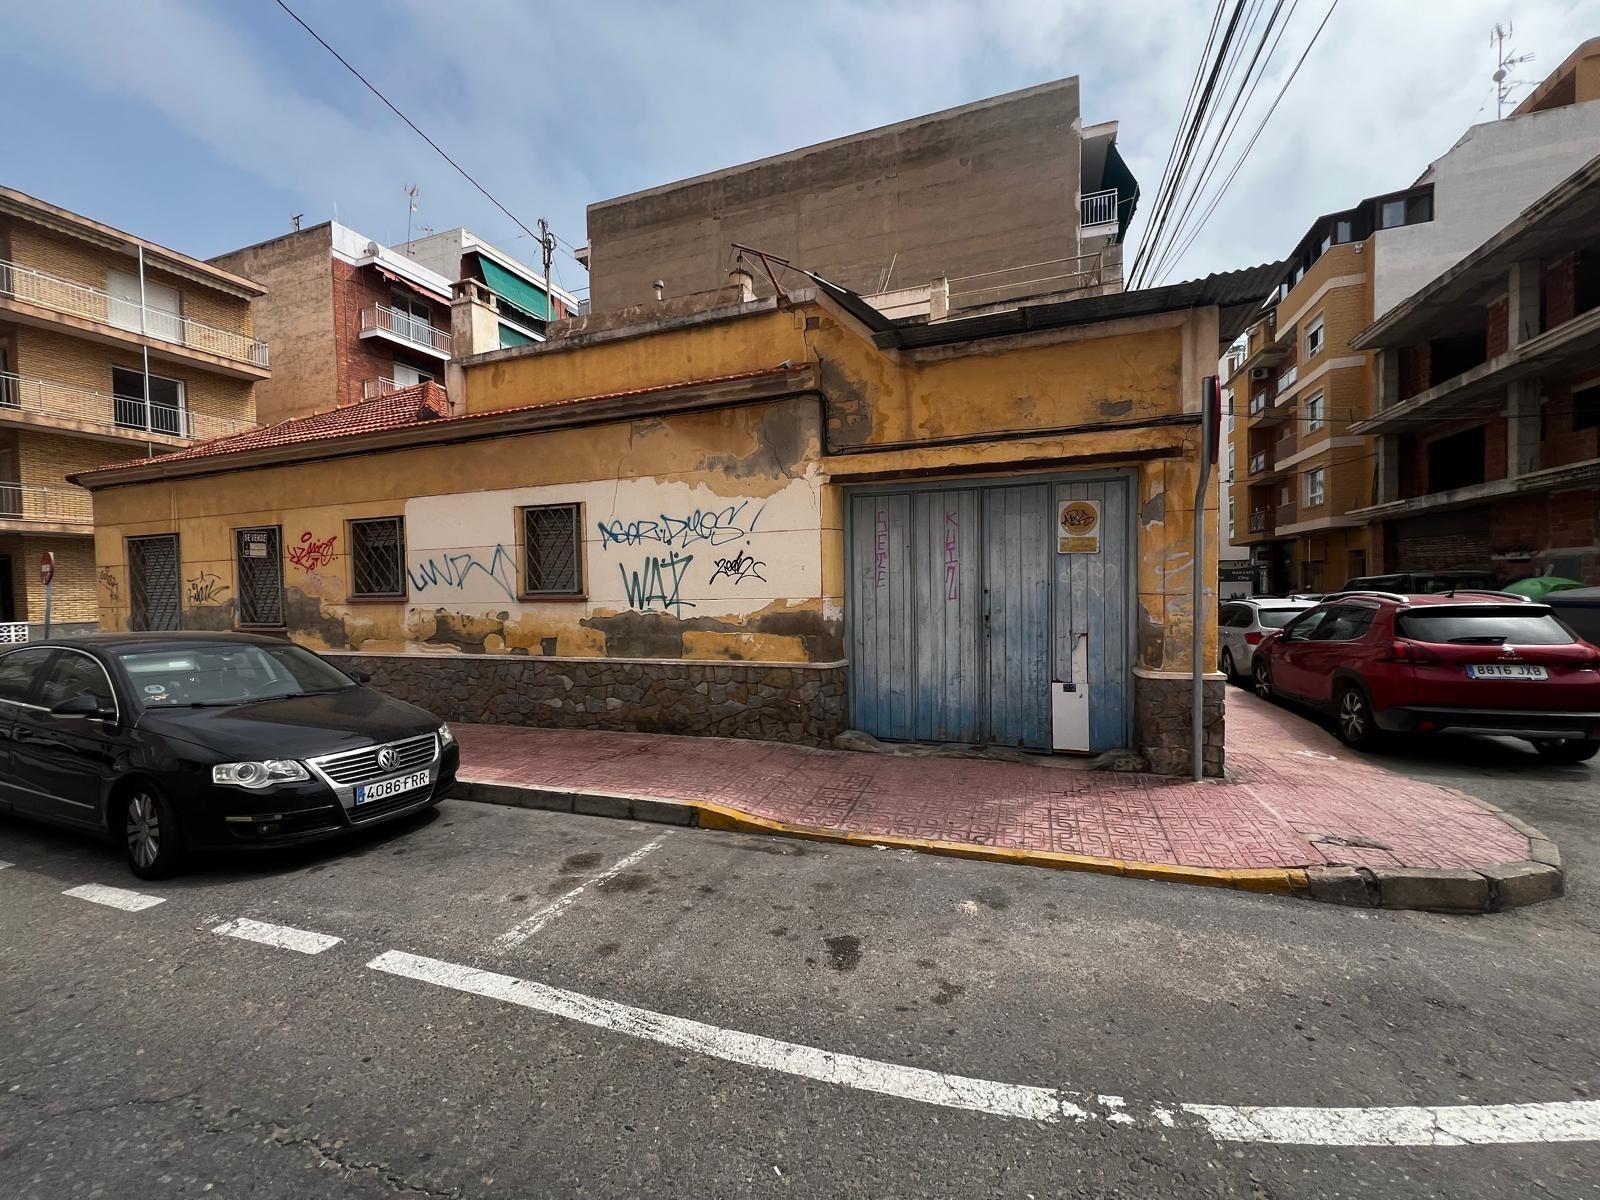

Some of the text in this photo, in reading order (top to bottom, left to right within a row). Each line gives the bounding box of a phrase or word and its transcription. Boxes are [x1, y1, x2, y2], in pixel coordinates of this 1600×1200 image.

[251, 533, 267, 542] VENDE
[1476, 665, 1512, 675] 8816
[367, 772, 426, 799] 4086 FRR
